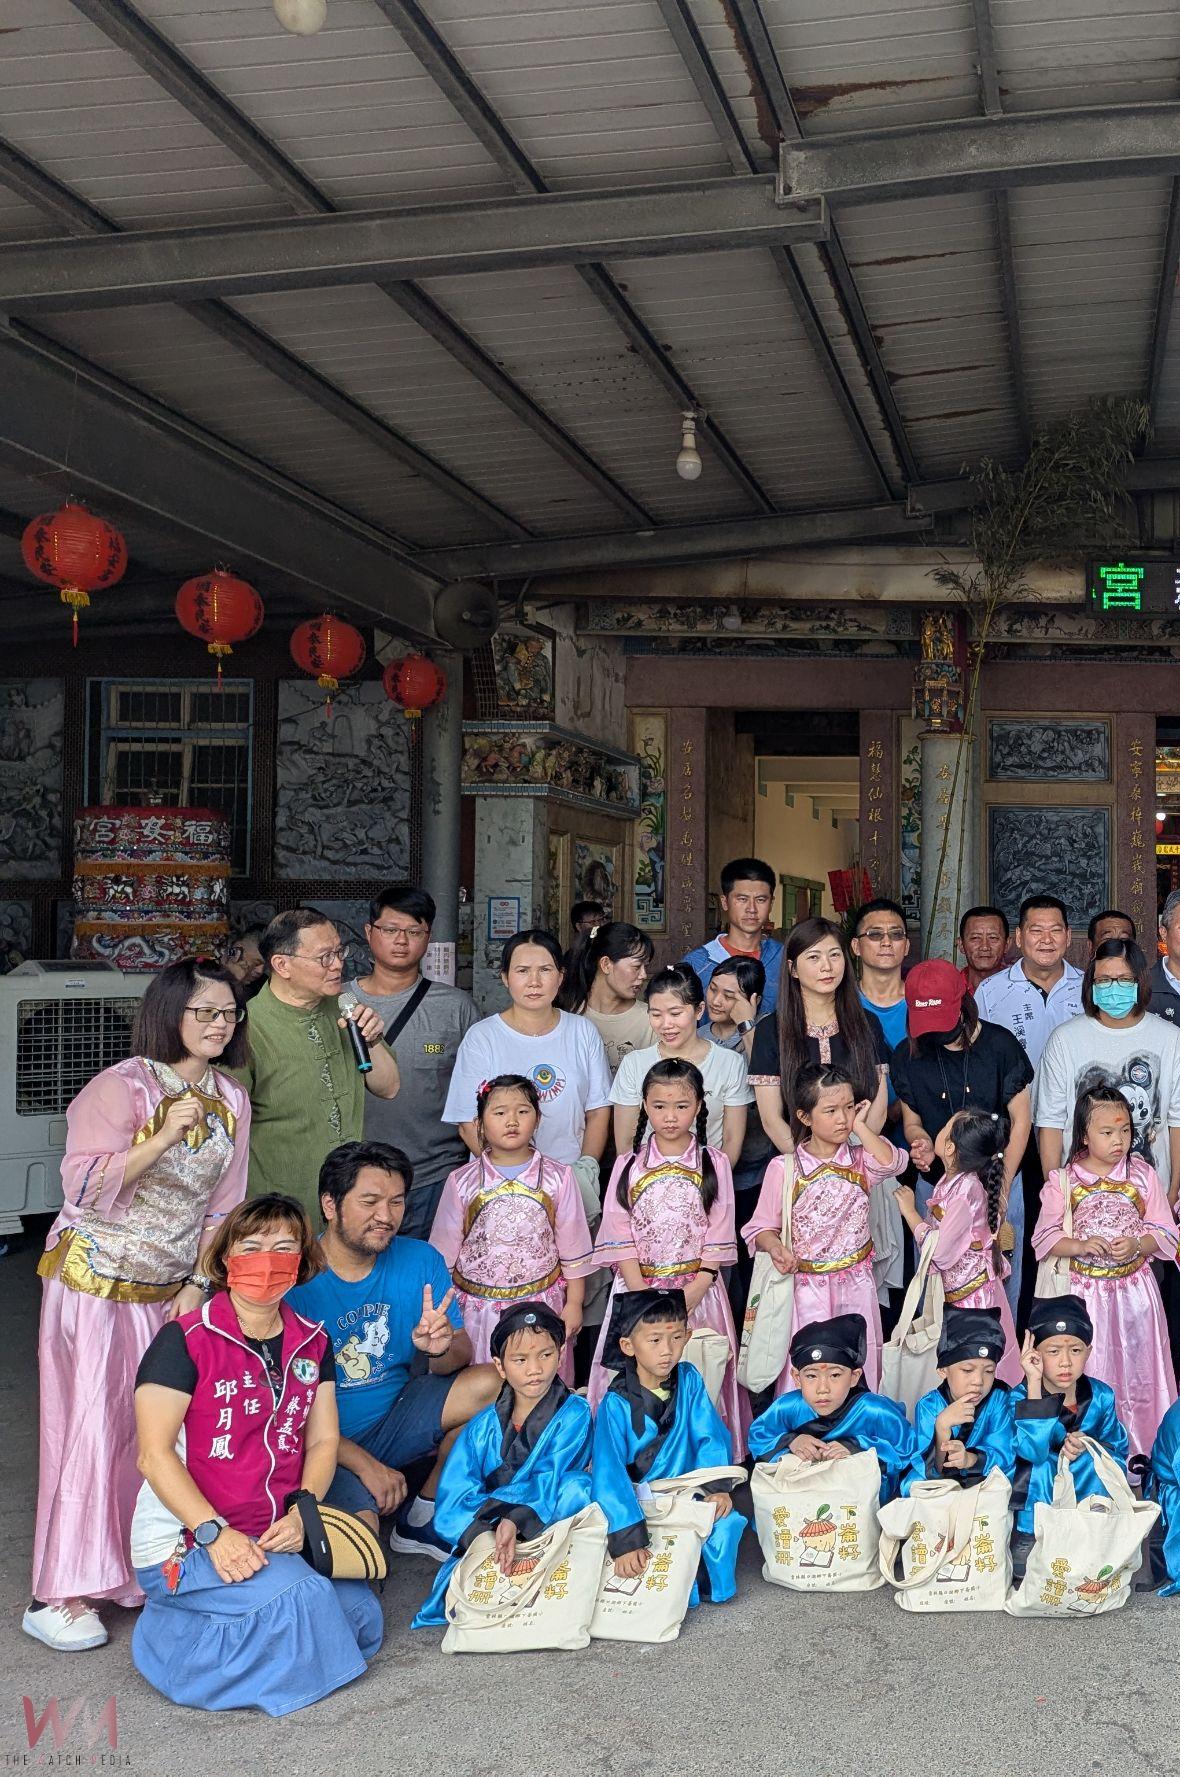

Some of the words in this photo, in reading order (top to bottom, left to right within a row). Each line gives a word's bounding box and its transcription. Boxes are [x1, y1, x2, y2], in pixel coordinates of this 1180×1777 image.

[1101, 563, 1144, 609] 宮
[208, 1379, 238, 1460] 邱月鳳
[243, 1371, 261, 1415] 主任
[772, 1505, 794, 1566] 愛讀冊
